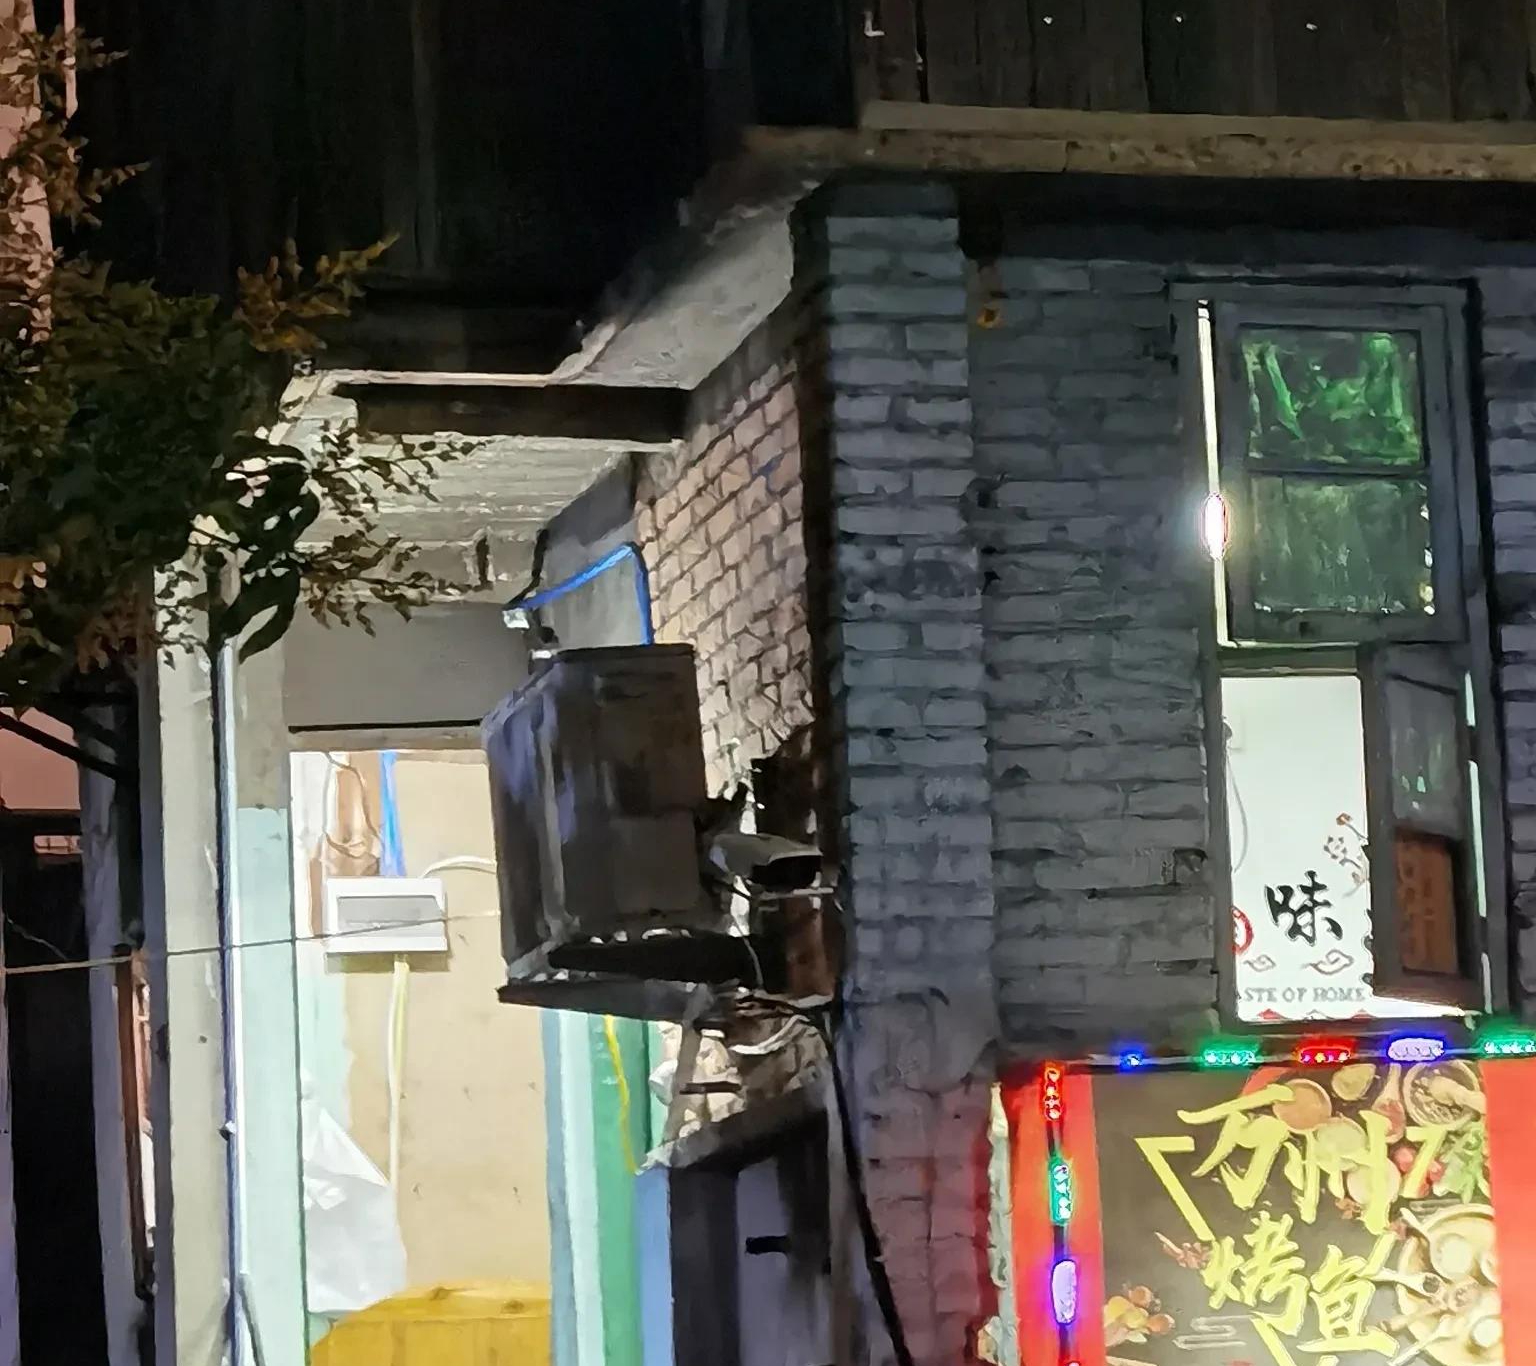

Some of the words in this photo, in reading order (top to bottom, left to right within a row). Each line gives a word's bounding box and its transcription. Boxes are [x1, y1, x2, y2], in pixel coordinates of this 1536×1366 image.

[1265, 870, 1343, 943] 味
[1177, 1084, 1394, 1236] 万州
[1201, 1210, 1401, 1358] 烤鱼
